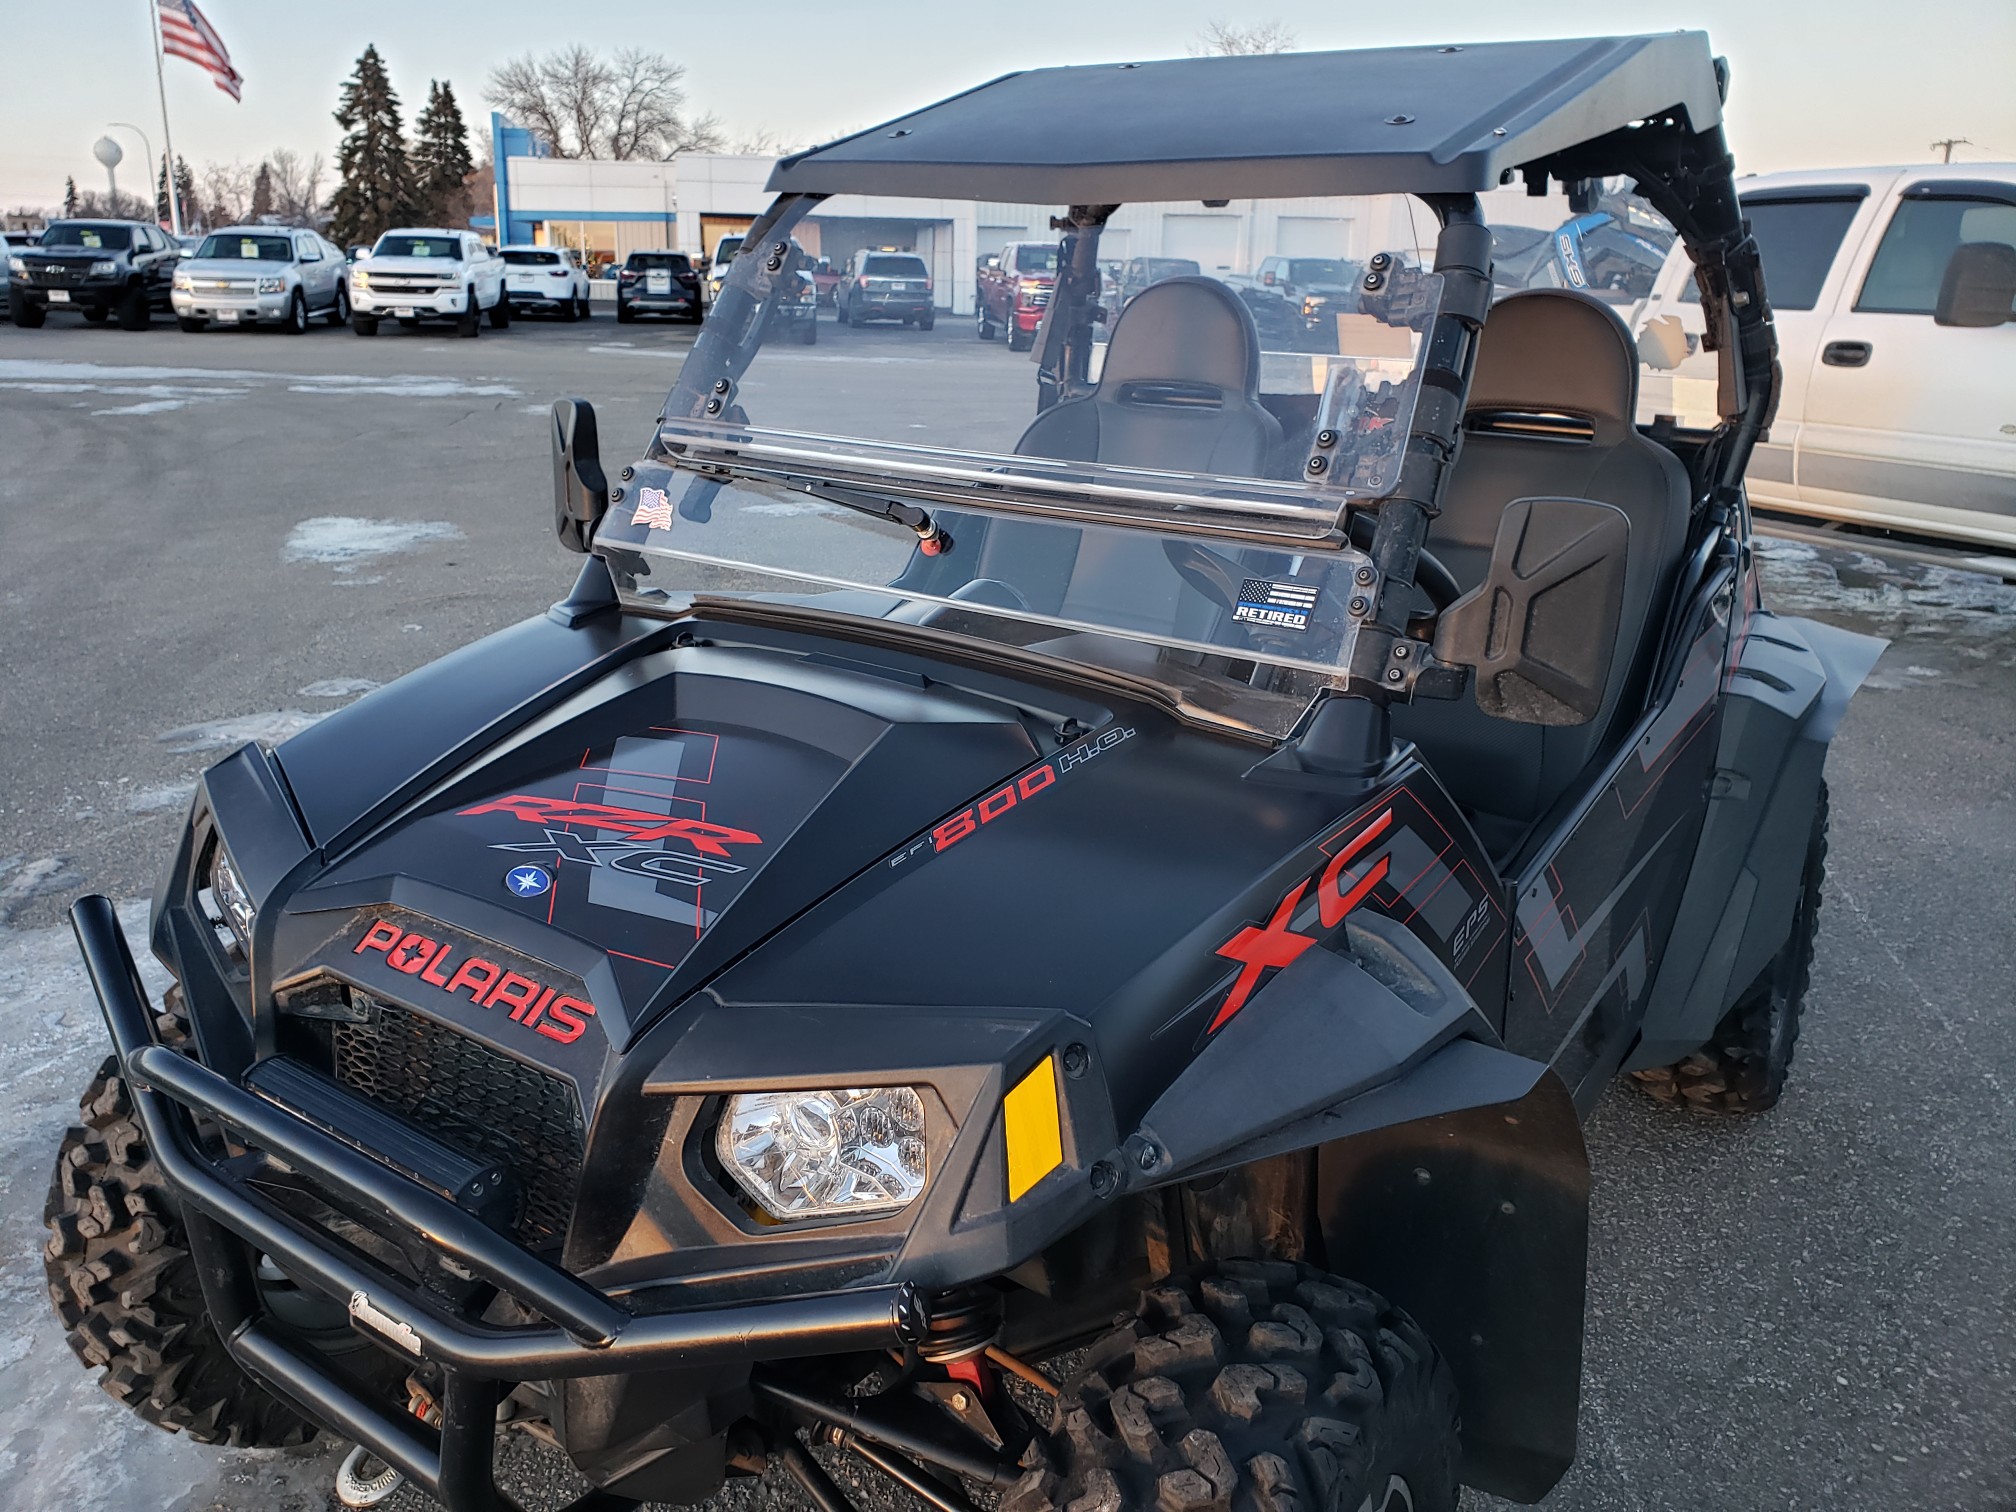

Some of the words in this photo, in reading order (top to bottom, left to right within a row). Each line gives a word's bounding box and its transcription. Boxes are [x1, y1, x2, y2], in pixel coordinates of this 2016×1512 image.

[1236, 606, 1306, 625] RETIRED
[455, 795, 763, 857] RZR
[889, 836, 933, 868] EFI
[932, 764, 1056, 852] 800
[1058, 727, 1137, 773] H.O.
[487, 828, 749, 887] XC
[1207, 807, 1393, 1035] XC
[1453, 893, 1489, 957] EPS
[354, 919, 597, 1044] POLARIS
[370, 1469, 398, 1492] CHIN
